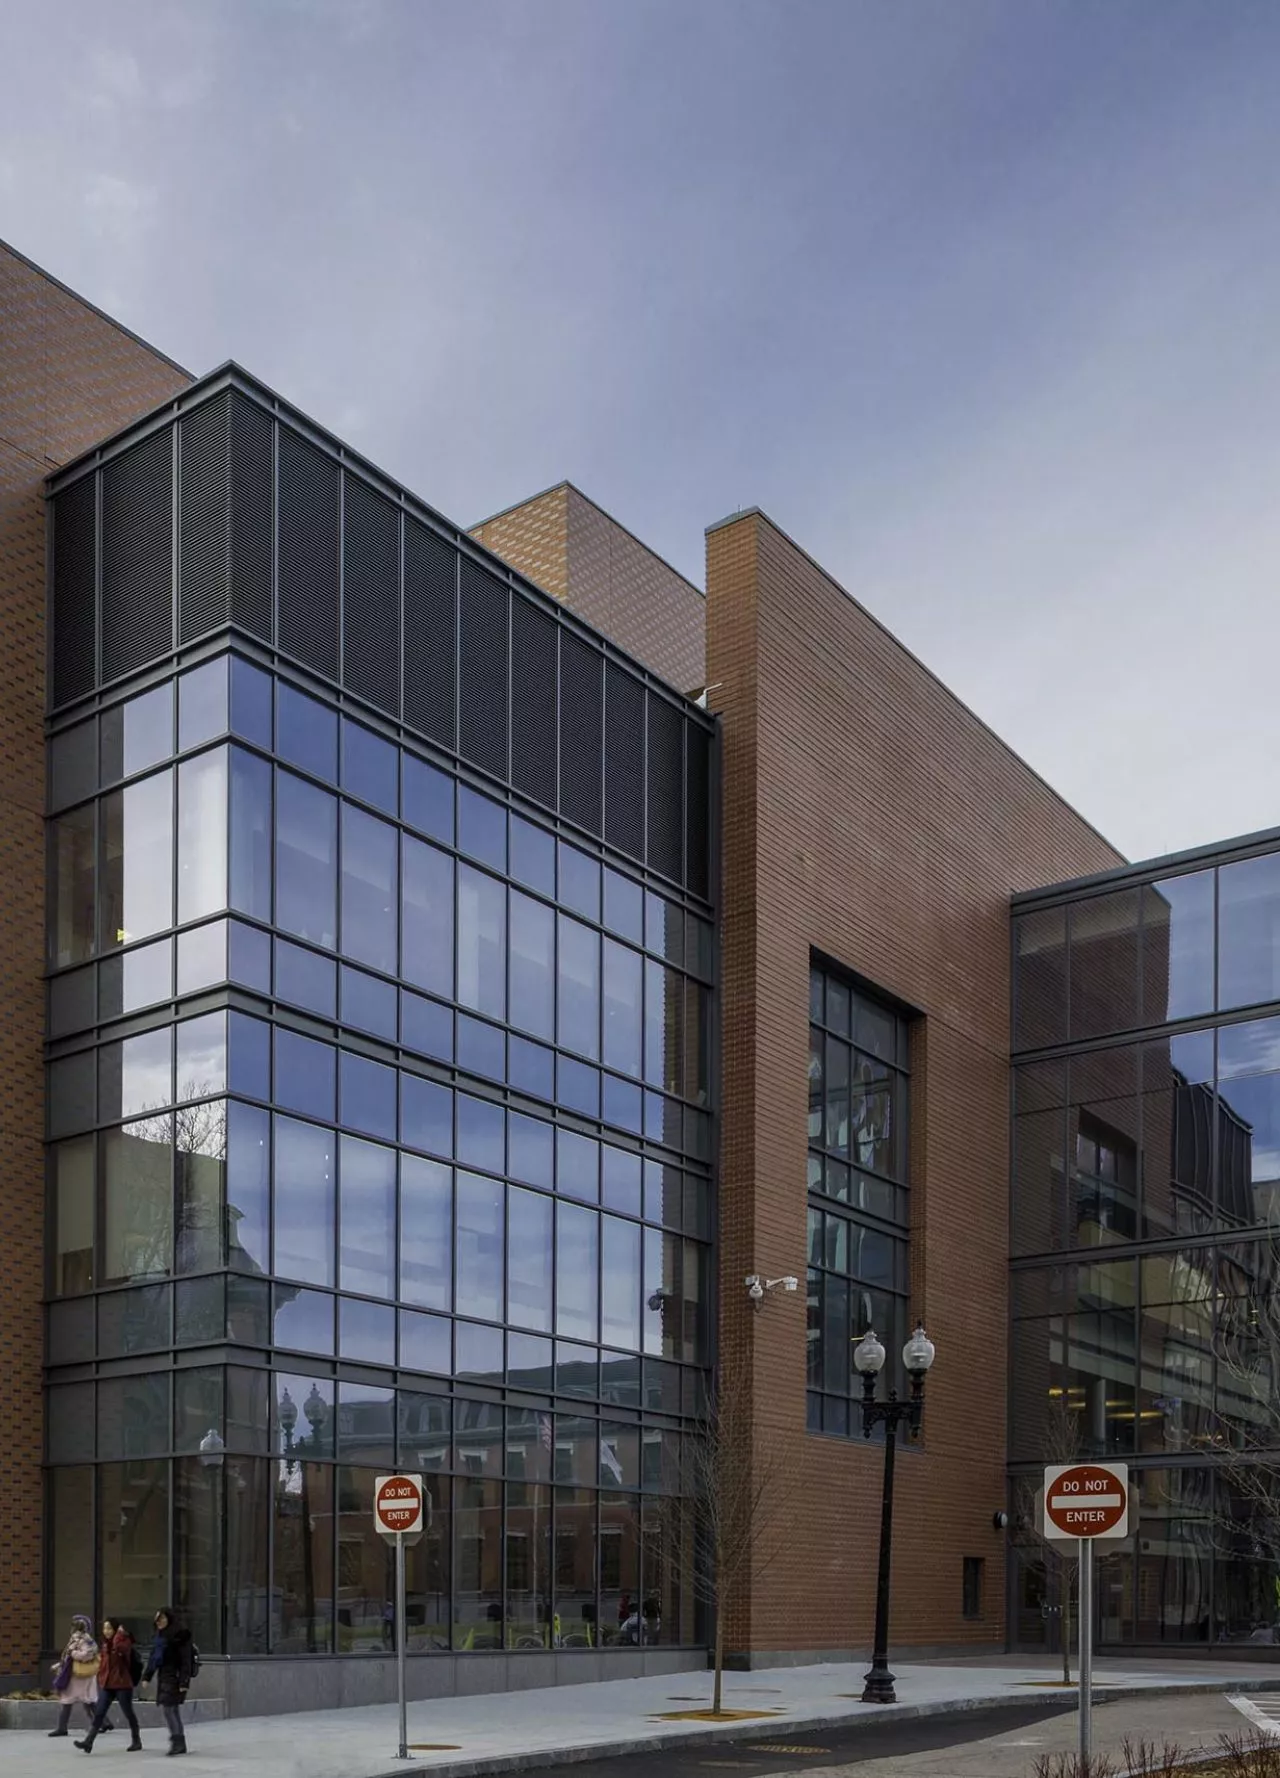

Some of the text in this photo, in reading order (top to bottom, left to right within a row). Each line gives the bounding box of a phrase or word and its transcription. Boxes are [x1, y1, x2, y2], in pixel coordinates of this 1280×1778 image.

[1063, 1480, 1108, 1492] DO NOT
[385, 1487, 411, 1497] DO NOT
[387, 1511, 410, 1520] ENTER
[1066, 1510, 1105, 1522] ENTER
